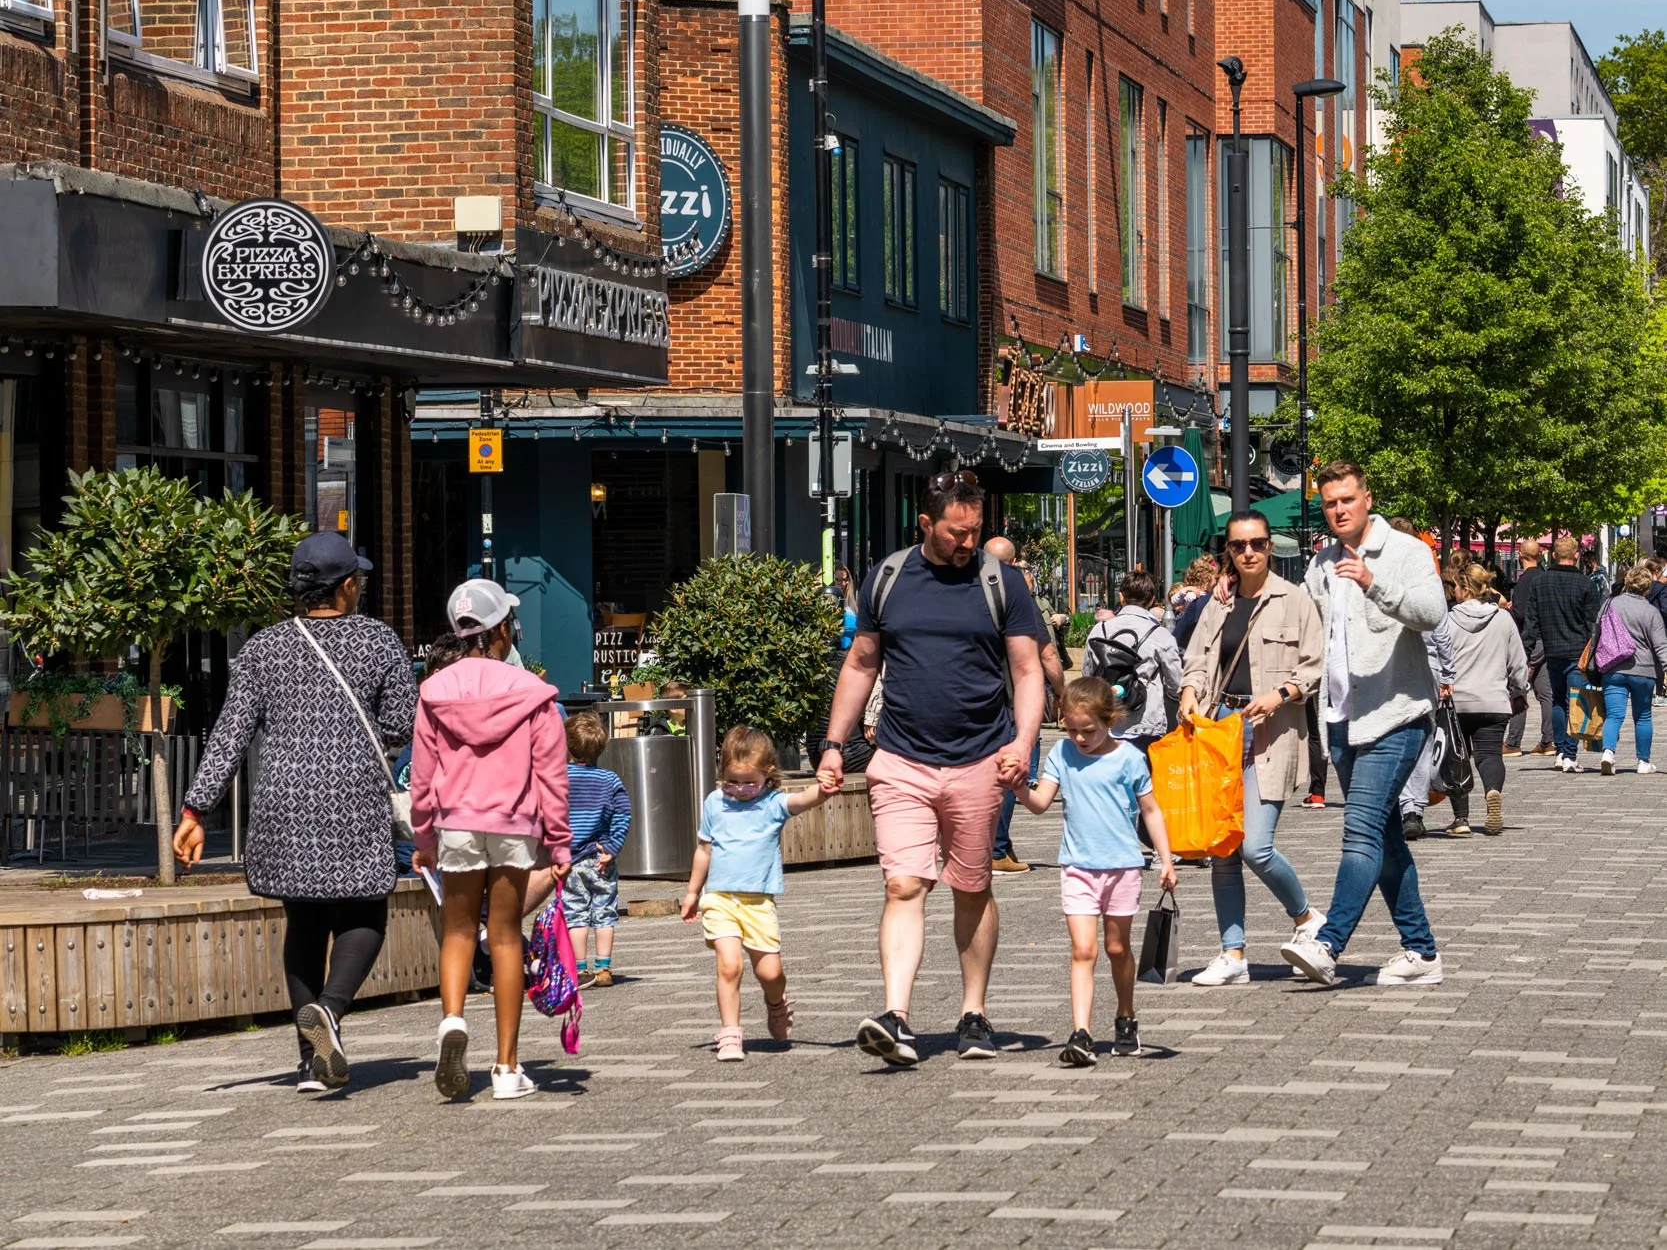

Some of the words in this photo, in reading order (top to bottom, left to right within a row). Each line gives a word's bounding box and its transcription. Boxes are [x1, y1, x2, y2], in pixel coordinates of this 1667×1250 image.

[660, 137, 706, 170] IDUALLY
[235, 247, 299, 263] PIZZA
[217, 263, 316, 280] EXPRESS
[1088, 402, 1151, 415] WILDWOOD
[1067, 461, 1103, 473] Zizzi
[1071, 477, 1100, 488] ITALIAN
[596, 632, 623, 646] PIZZ
[593, 649, 643, 664] RUSTIC
